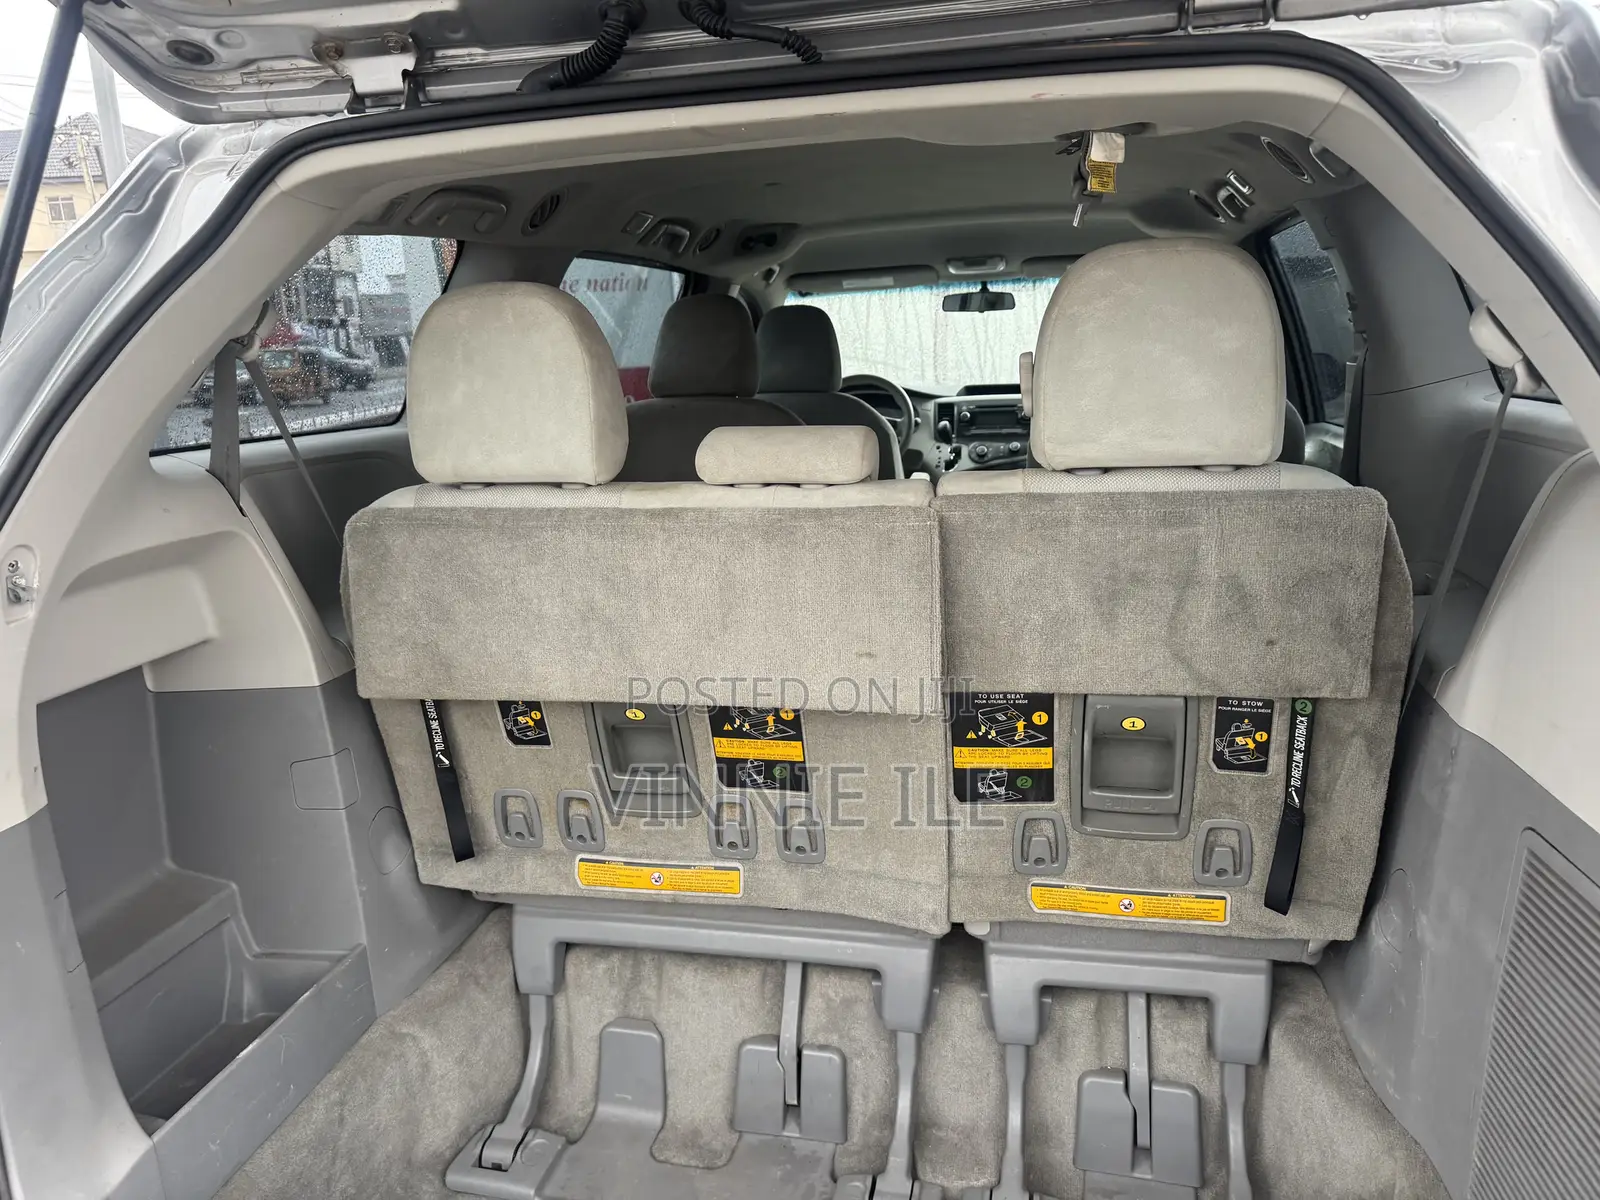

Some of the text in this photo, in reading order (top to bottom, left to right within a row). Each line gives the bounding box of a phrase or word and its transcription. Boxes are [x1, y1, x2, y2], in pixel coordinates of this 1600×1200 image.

[429, 719, 443, 743] RECLINE
[435, 743, 445, 751] TO
[1290, 714, 1308, 788] TO RECLINE SEATBACK
